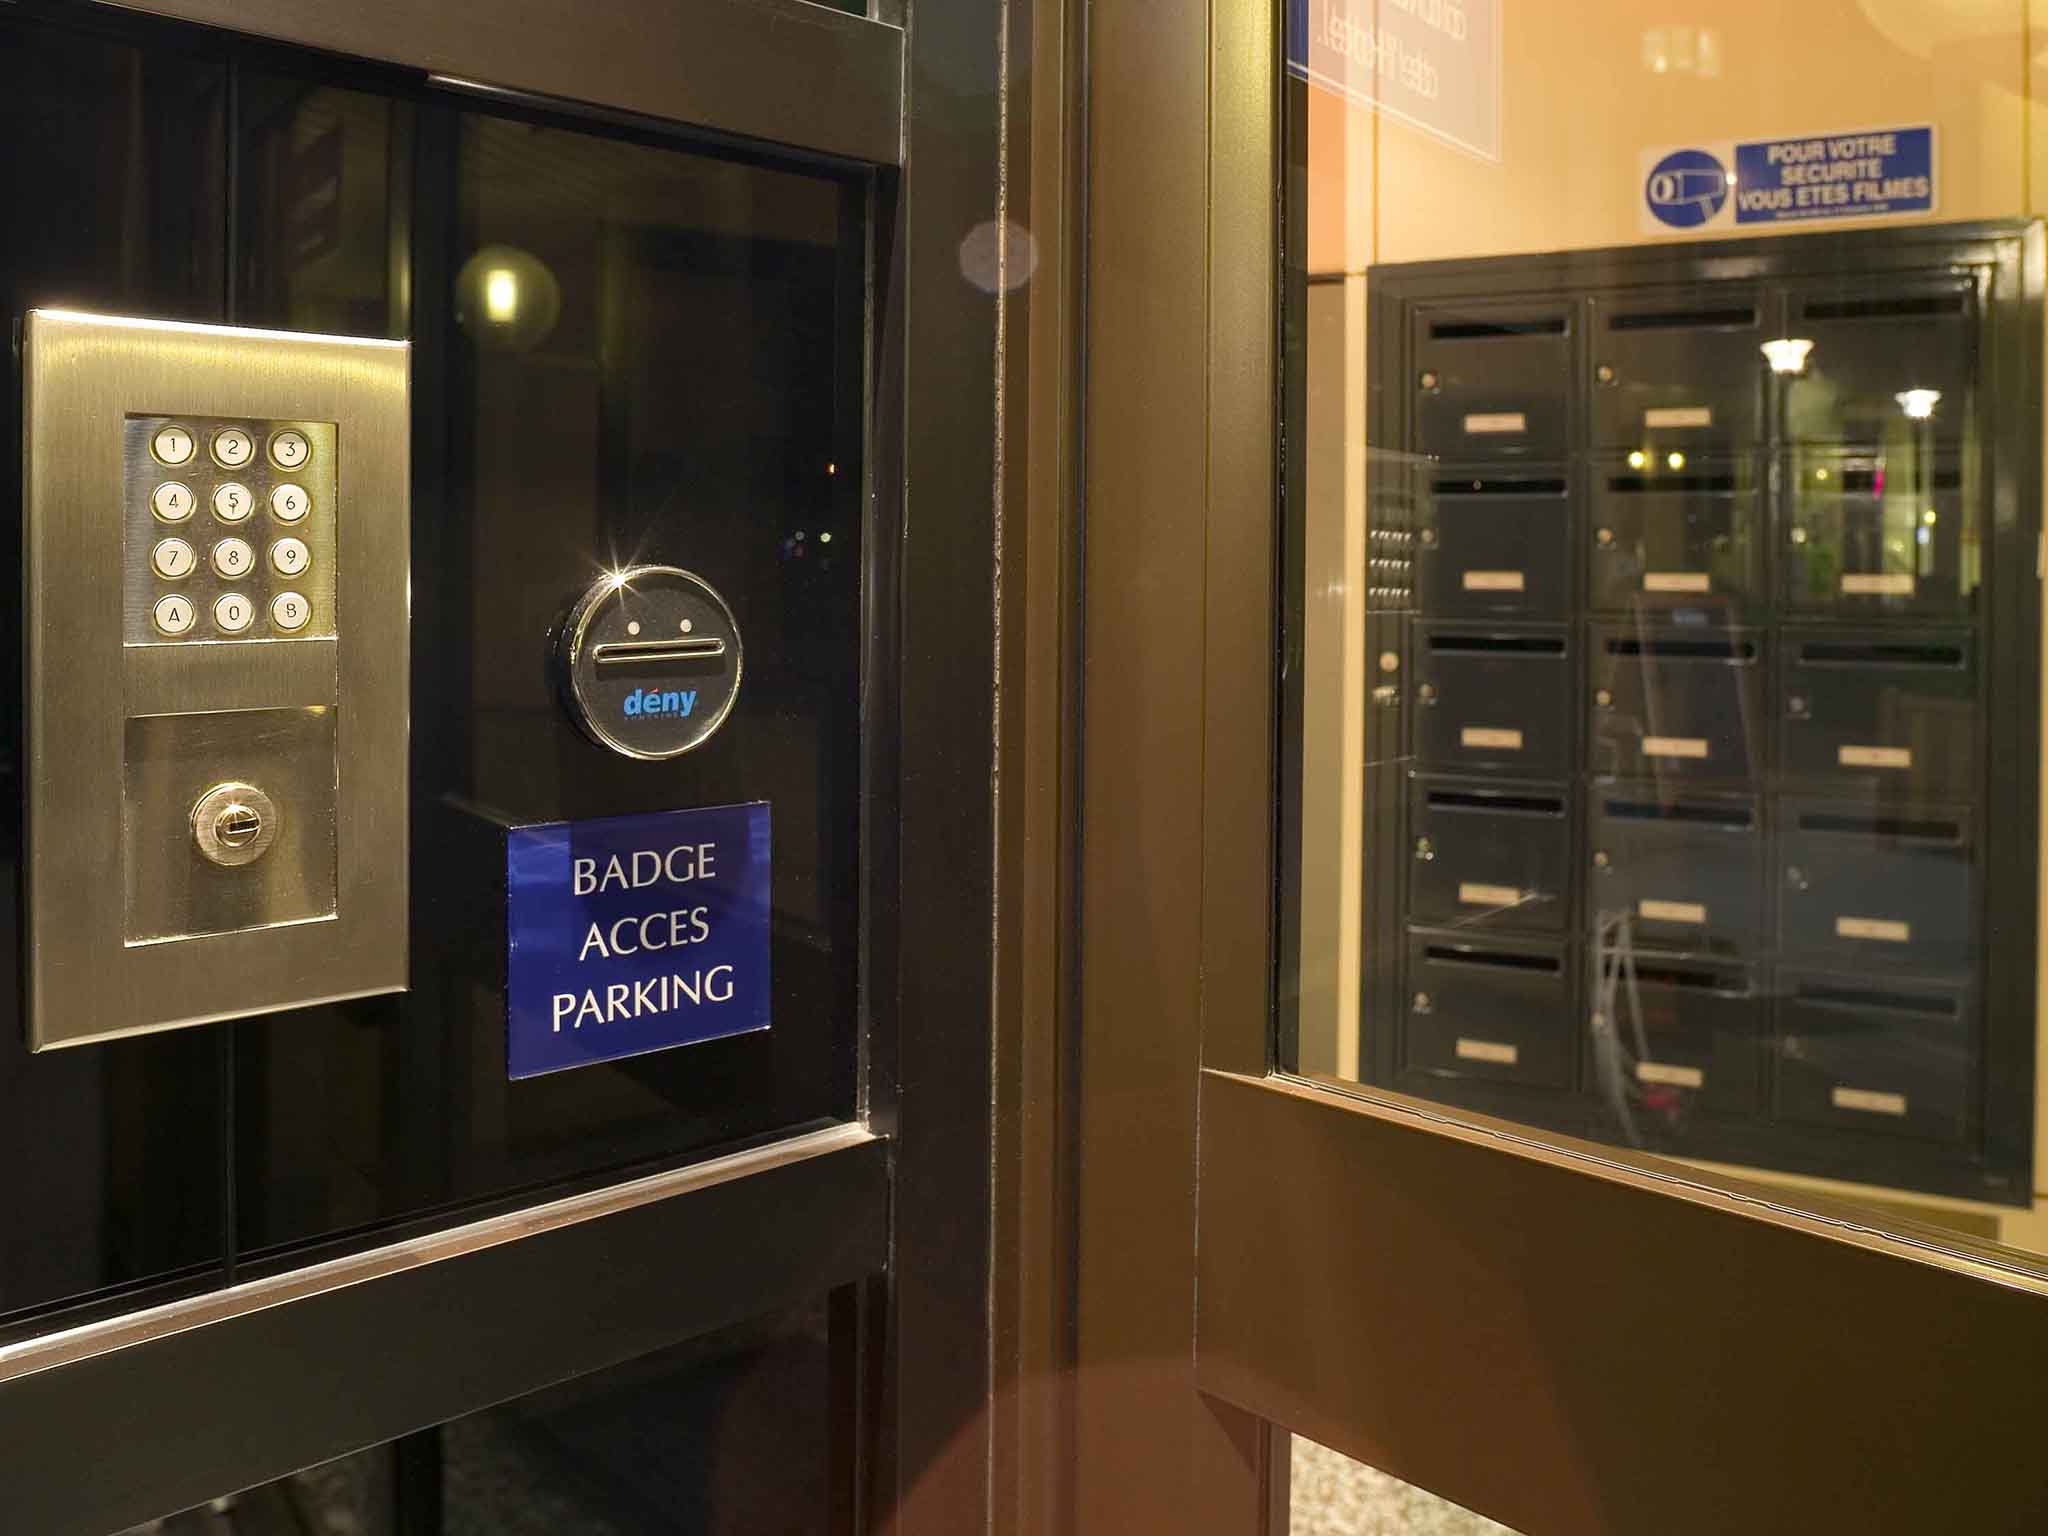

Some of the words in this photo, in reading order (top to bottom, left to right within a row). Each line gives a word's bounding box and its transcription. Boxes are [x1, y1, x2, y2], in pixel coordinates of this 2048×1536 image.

[1767, 142, 1826, 165] POUR
[1827, 134, 1896, 160] VOTRE
[1780, 158, 1883, 186] SECURITE
[1738, 188, 1793, 211] VOUS
[1795, 182, 1850, 208] ETES
[1853, 176, 1929, 202] FILMES
[228, 439, 239, 455] 2
[285, 441, 296, 457] 3
[168, 493, 179, 508] 4
[229, 492, 239, 506] 5
[286, 495, 296, 510] 6
[169, 550, 179, 567] 7
[228, 550, 239, 565] 8
[286, 549, 297, 565] 9
[168, 607, 180, 623] A
[286, 603, 297, 618] B
[573, 842, 716, 896] BADGE
[579, 906, 711, 961] ACCES
[552, 965, 734, 1032] PARKING
